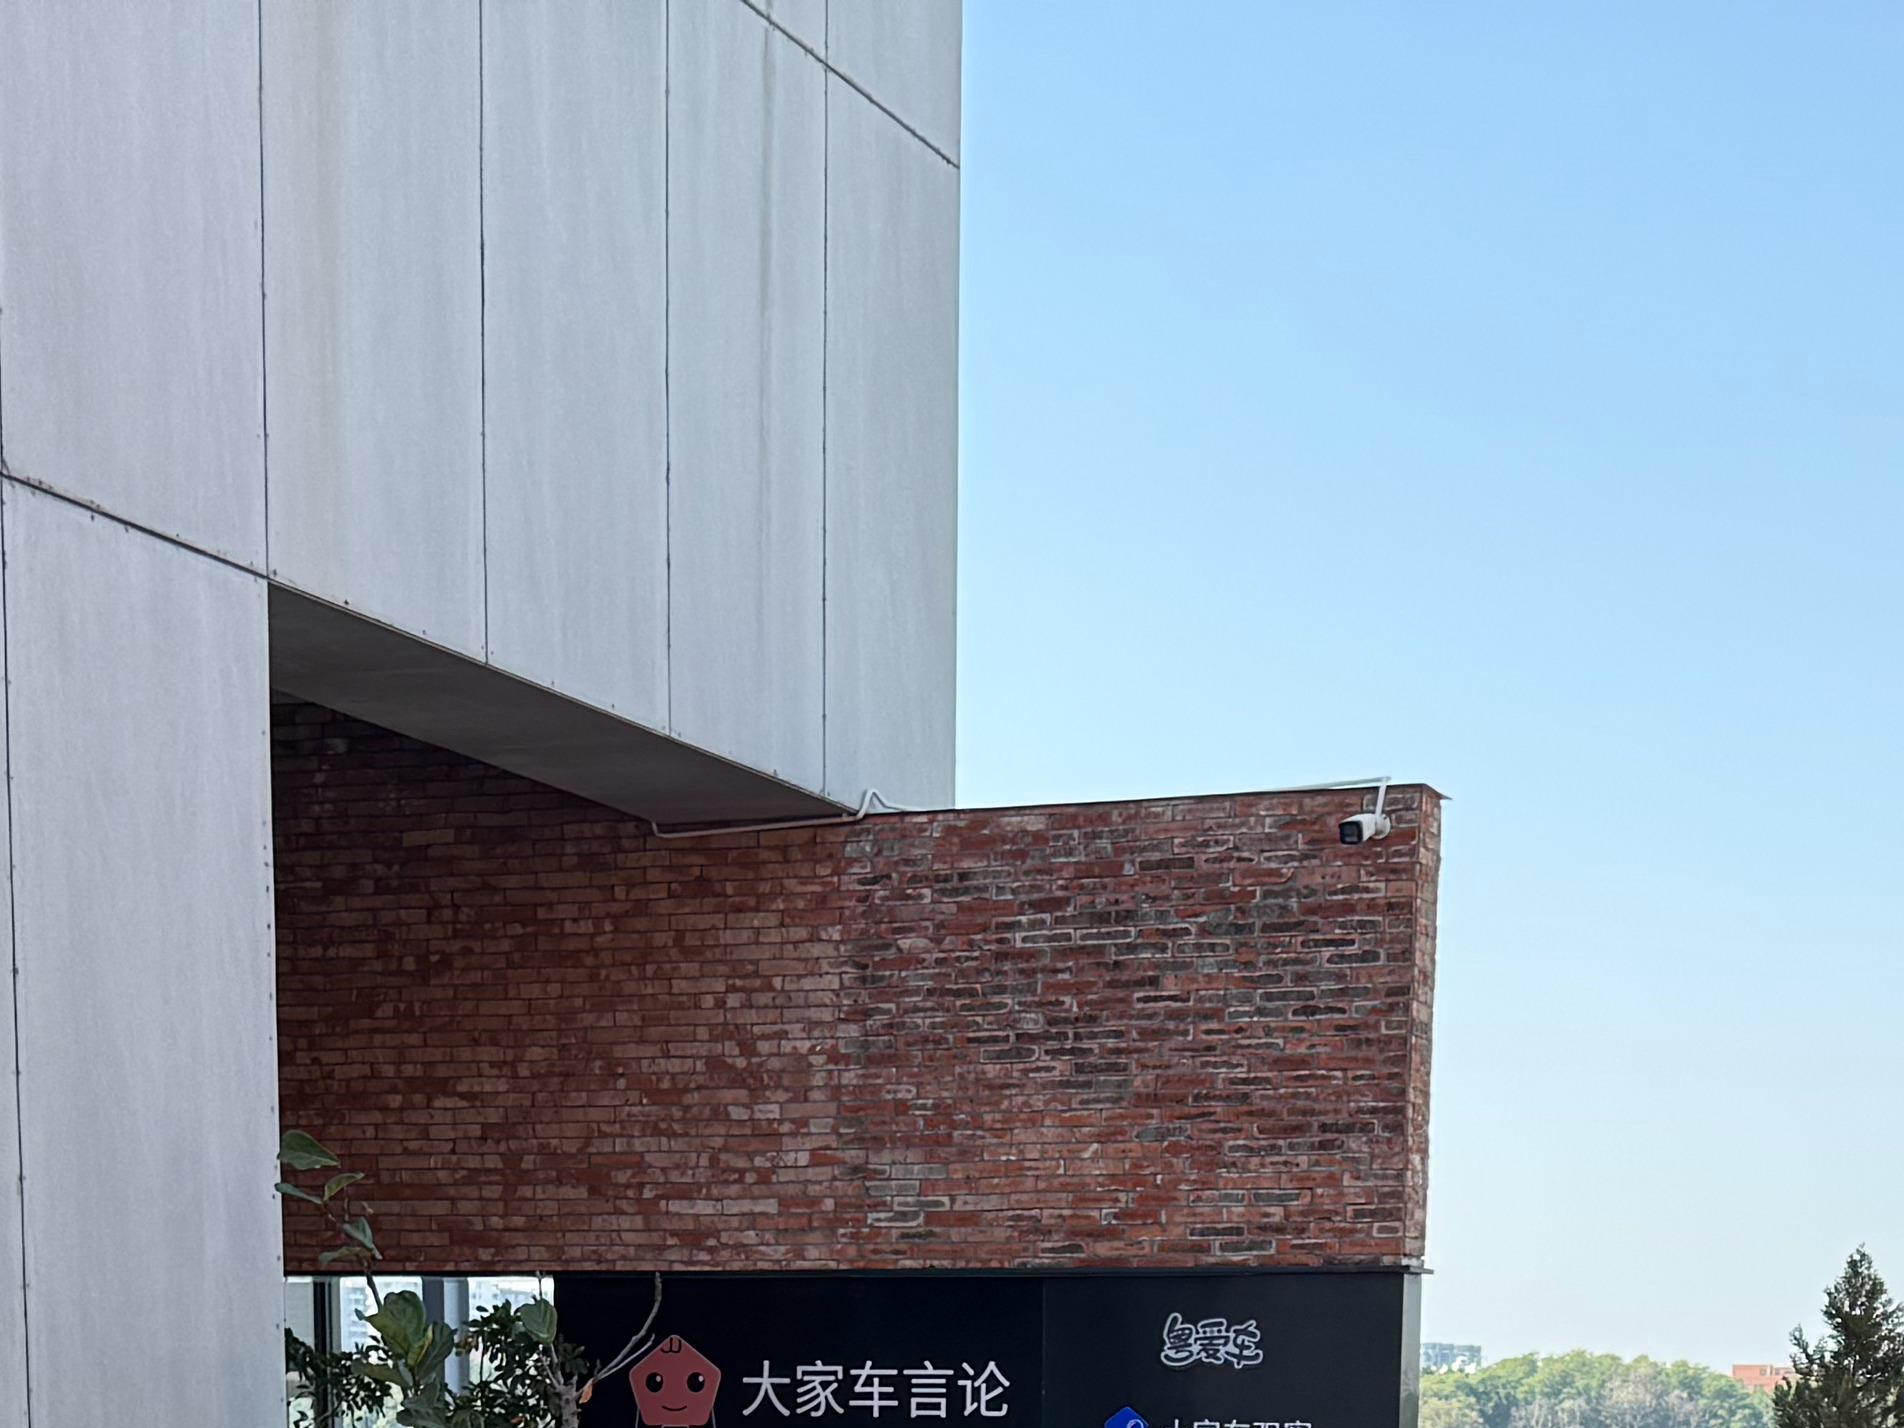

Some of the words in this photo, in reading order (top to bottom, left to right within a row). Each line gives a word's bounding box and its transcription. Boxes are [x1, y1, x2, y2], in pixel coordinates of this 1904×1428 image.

[1160, 1312, 1264, 1369] 粤爱车
[742, 1360, 1011, 1418] 大家车言论
